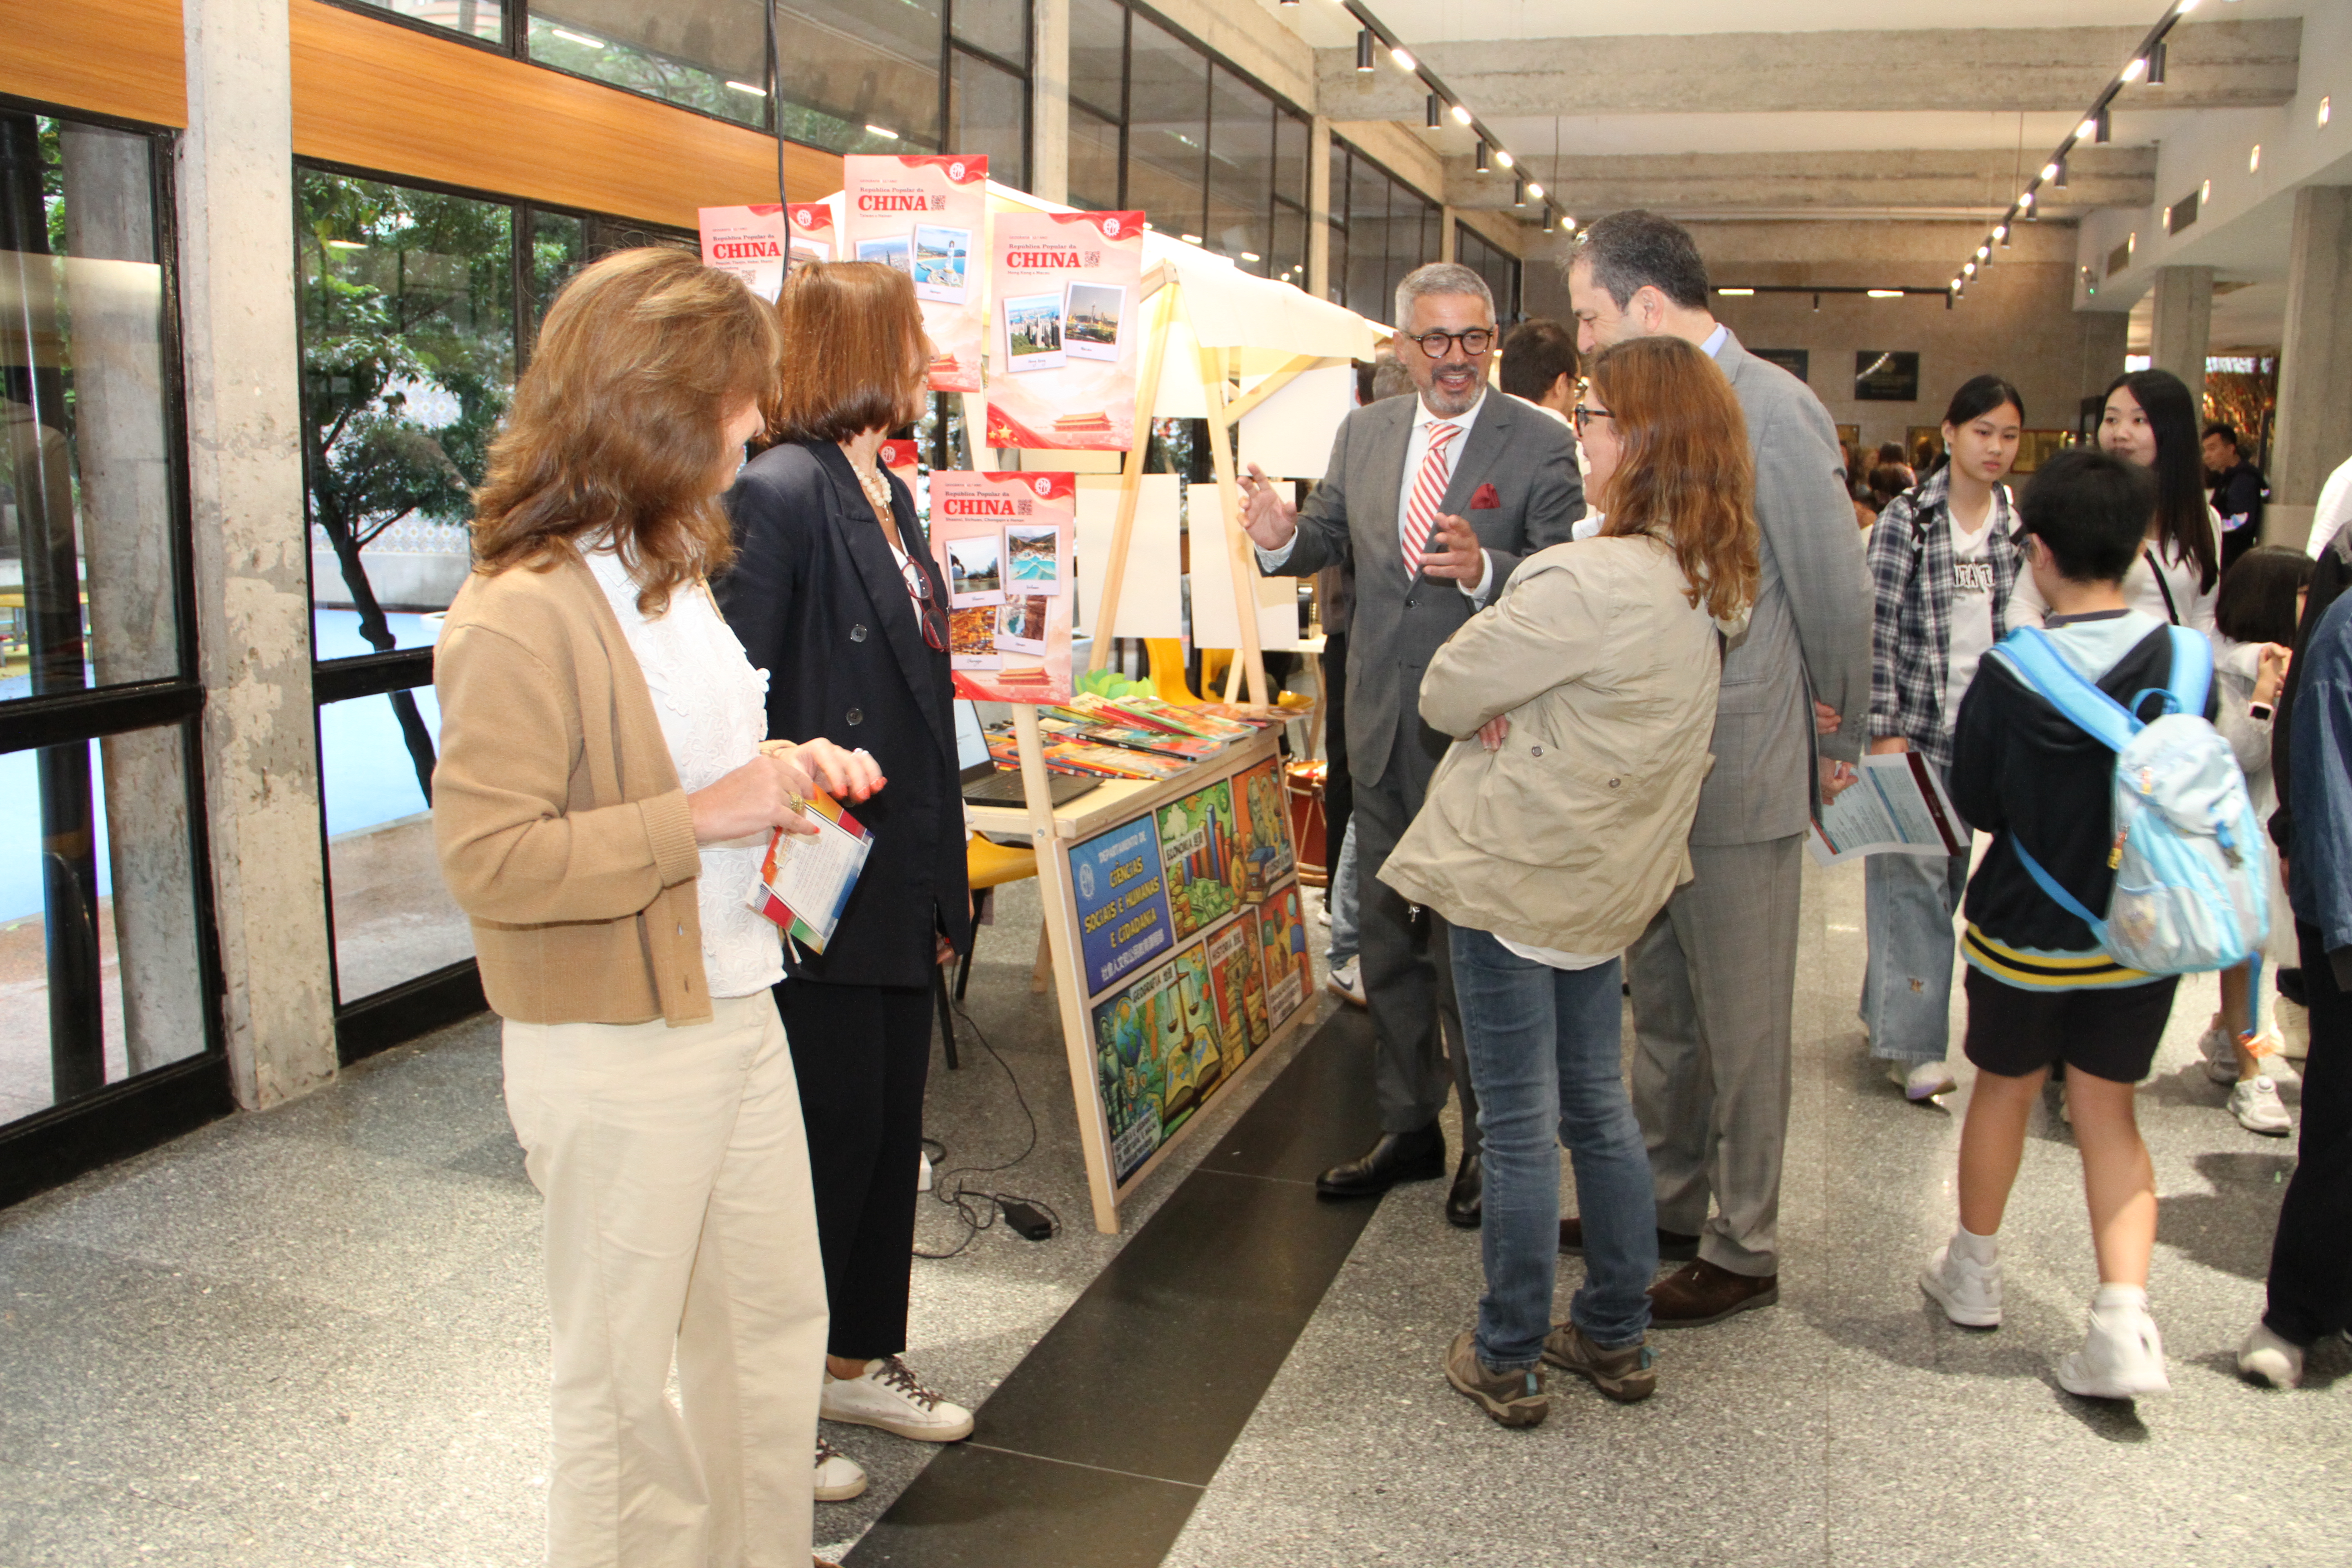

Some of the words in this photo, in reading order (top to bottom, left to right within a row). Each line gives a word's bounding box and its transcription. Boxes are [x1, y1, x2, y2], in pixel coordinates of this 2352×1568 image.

[858, 195, 928, 211] CHINA
[713, 241, 782, 259] CHINA
[1006, 251, 1082, 268] CHINA
[944, 499, 1016, 515] CHINA
[1166, 838, 1191, 861] ECONOMIA
[1117, 897, 1124, 914] E
[1125, 875, 1160, 909] HUMANAS
[1110, 931, 1117, 948] E
[1118, 907, 1157, 944] CIDADANIA
